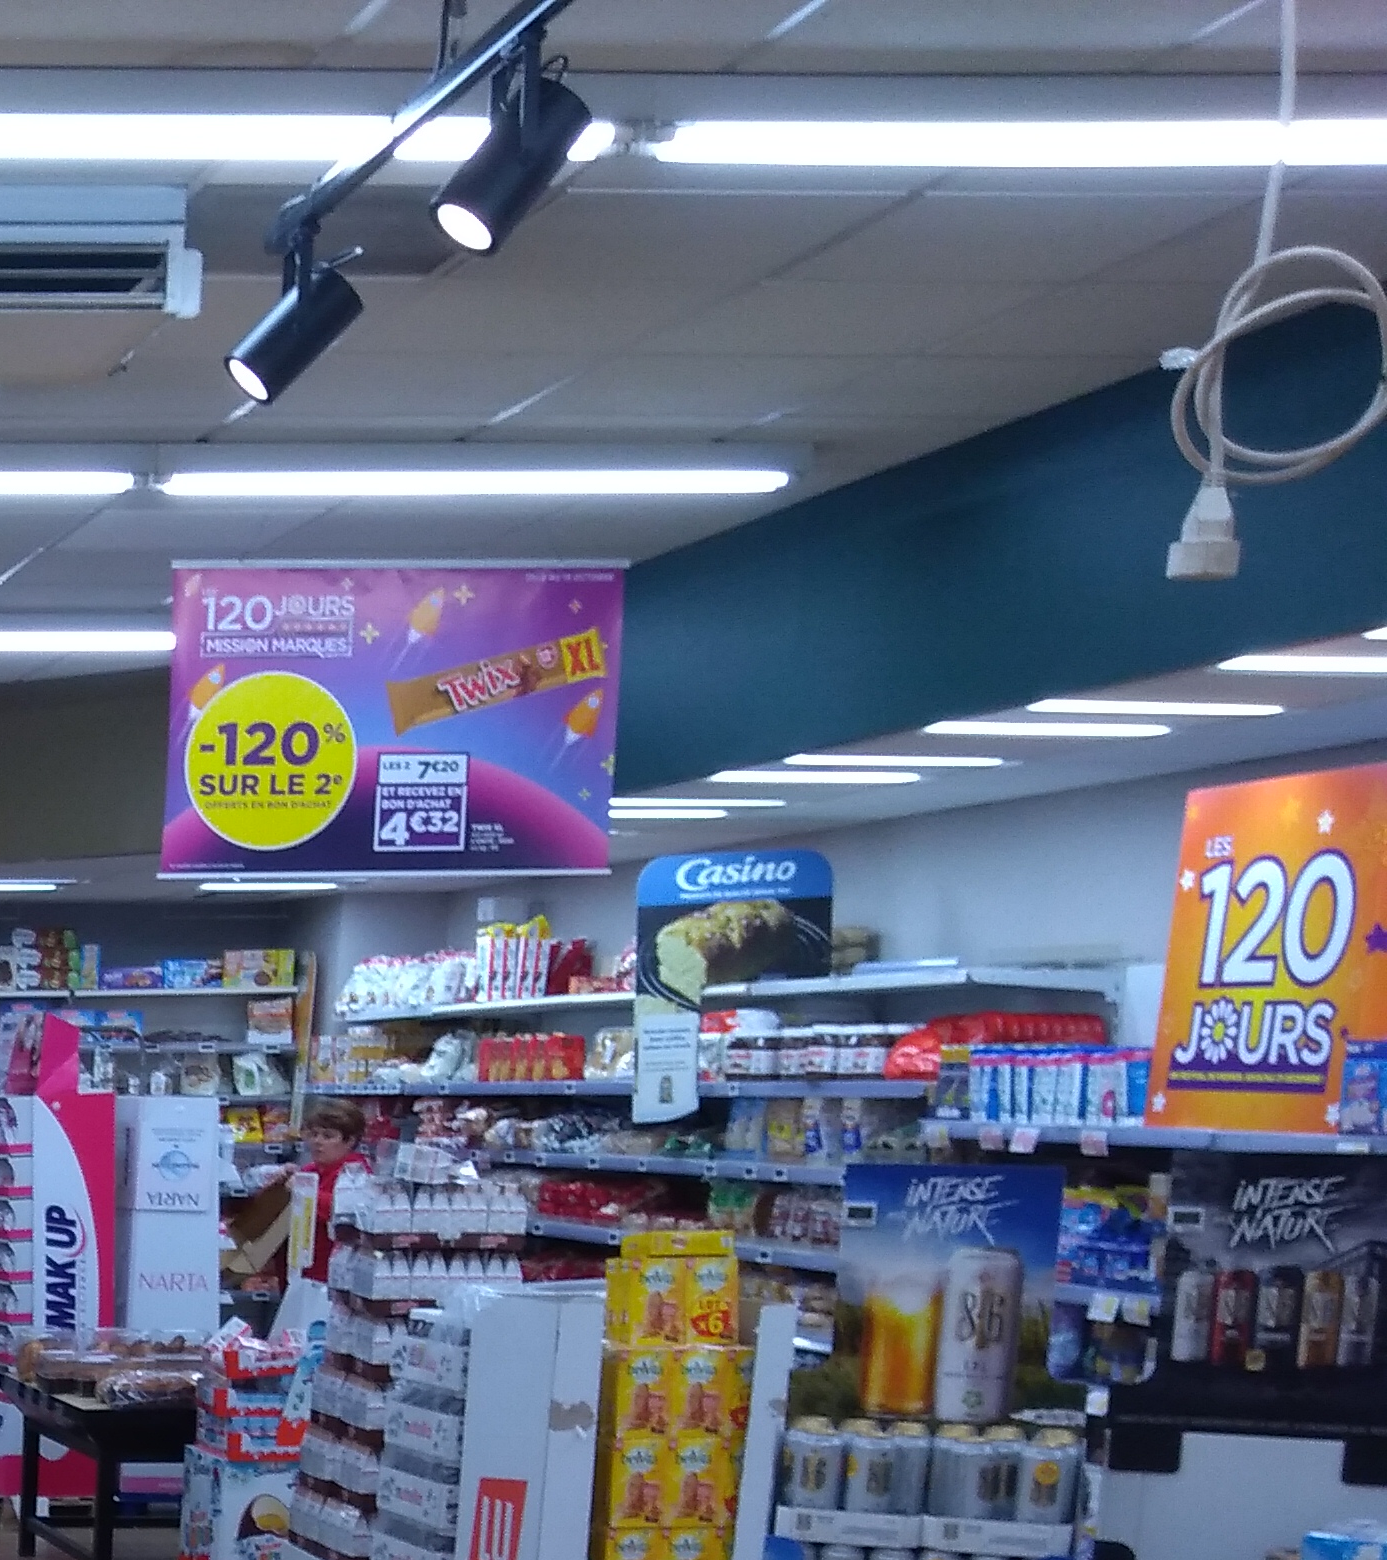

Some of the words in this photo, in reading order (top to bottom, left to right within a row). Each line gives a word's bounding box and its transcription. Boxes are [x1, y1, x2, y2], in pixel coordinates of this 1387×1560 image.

[202, 595, 273, 631] 120
[275, 594, 355, 616] JOURS
[206, 637, 269, 653] MISSION
[272, 637, 348, 658] MARQUES
[567, 637, 601, 676] XL
[199, 774, 260, 796] SUR
[270, 774, 306, 796] LE
[1204, 835, 1235, 859] LES
[675, 855, 797, 891] Casino
[1198, 848, 1357, 989] 120
[139, 1272, 209, 1292] NARTA
